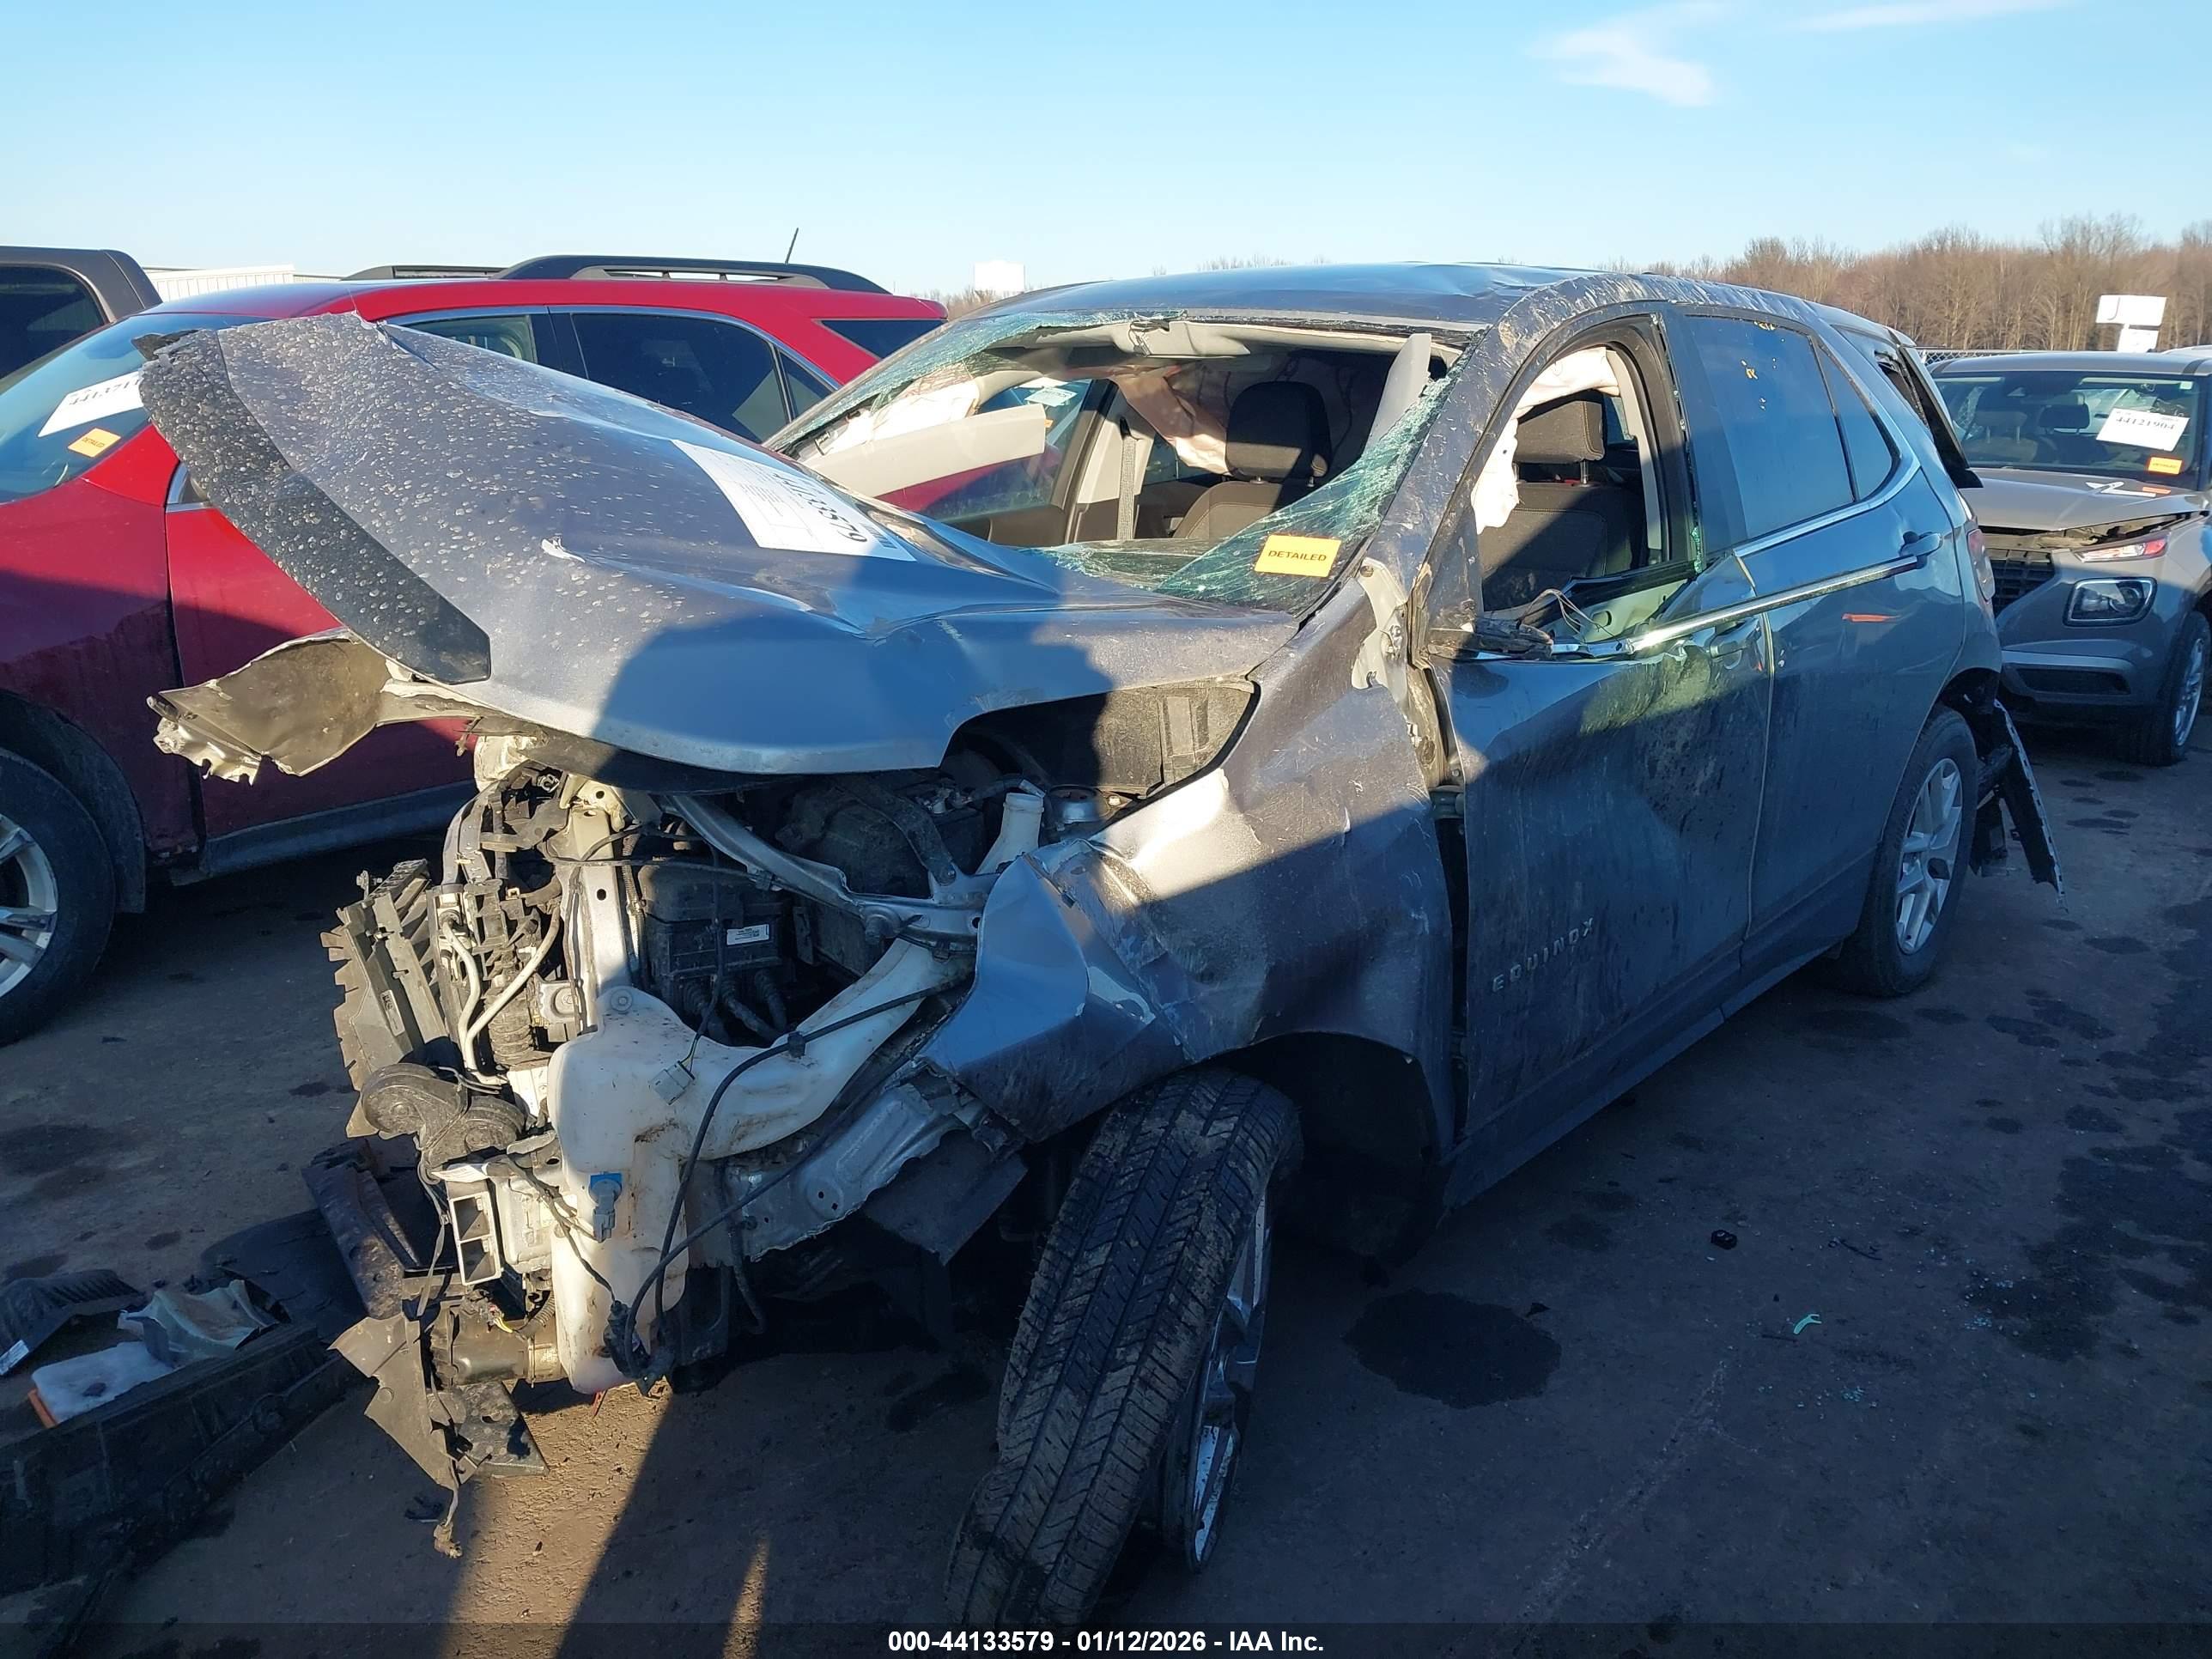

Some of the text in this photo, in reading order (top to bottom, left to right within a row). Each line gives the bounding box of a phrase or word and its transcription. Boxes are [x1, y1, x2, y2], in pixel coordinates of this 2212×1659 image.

[2115, 416, 2175, 430] 44121904
[1267, 550, 1328, 562] DETAILED
[1492, 917, 1594, 993] EQUINOX
